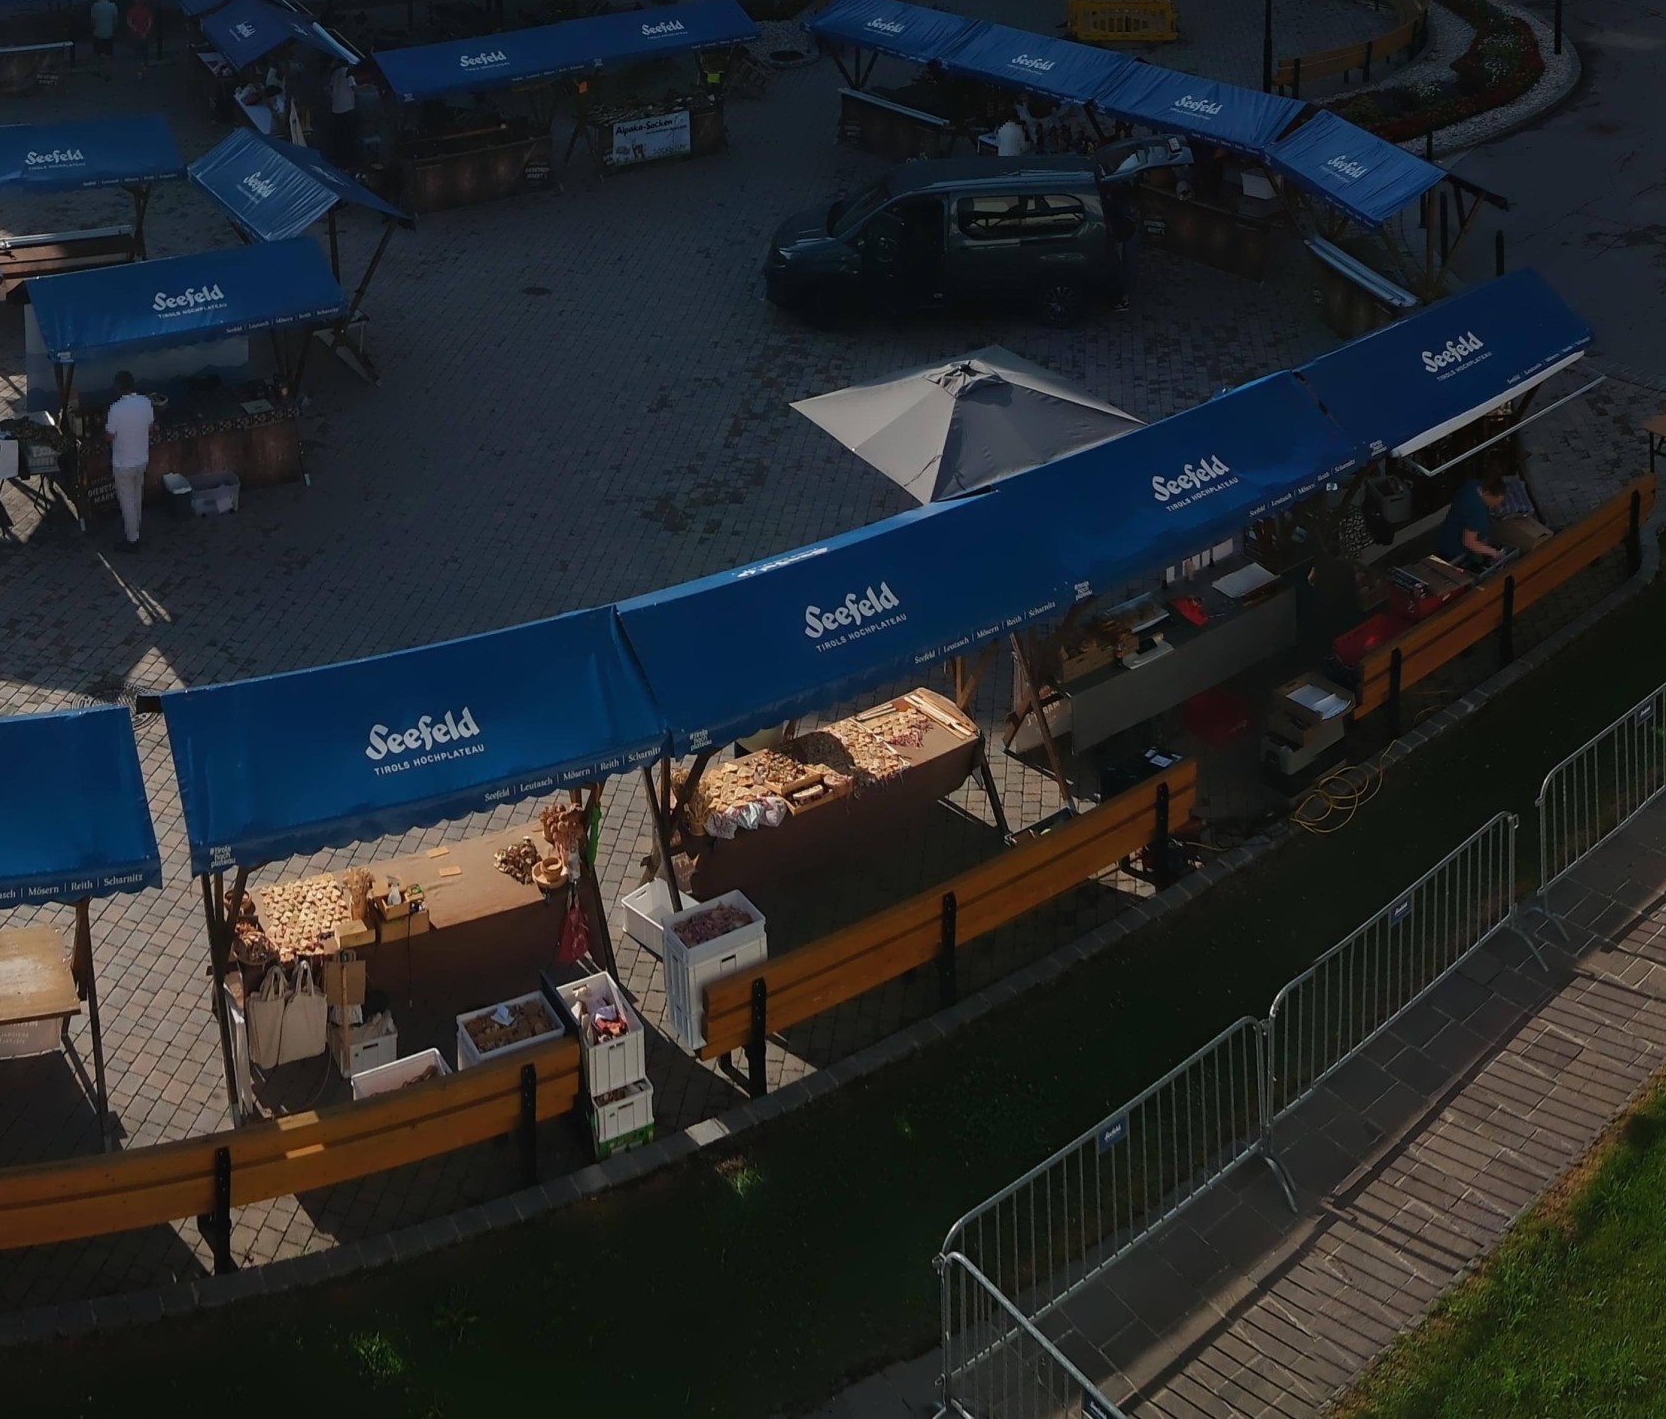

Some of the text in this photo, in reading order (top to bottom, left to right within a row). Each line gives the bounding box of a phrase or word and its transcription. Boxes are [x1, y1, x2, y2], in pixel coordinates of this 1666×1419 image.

[460, 50, 507, 68] Seefeld
[1175, 94, 1223, 115] Seefeld
[25, 148, 85, 166] Seefeld
[152, 284, 225, 312] Seefeld
[1422, 331, 1485, 373] Seefeld
[1152, 454, 1230, 502] Seefeld
[1166, 477, 1239, 513] TIROLS HOCHPLATEAU
[805, 581, 900, 639] Seefeld
[816, 613, 908, 653] TIROLS HOCHPLATEAU
[365, 706, 480, 760] Seefeld
[373, 744, 485, 777] TIROLS HOCHPLATEAU
[484, 787, 510, 802] Seefeld
[520, 778, 554, 793] Leutasch
[563, 768, 591, 782] Mösern
[600, 758, 620, 772] Reith
[28, 885, 59, 897] Mösern
[71, 880, 93, 891] Reith
[103, 873, 143, 887] Scharnitz
